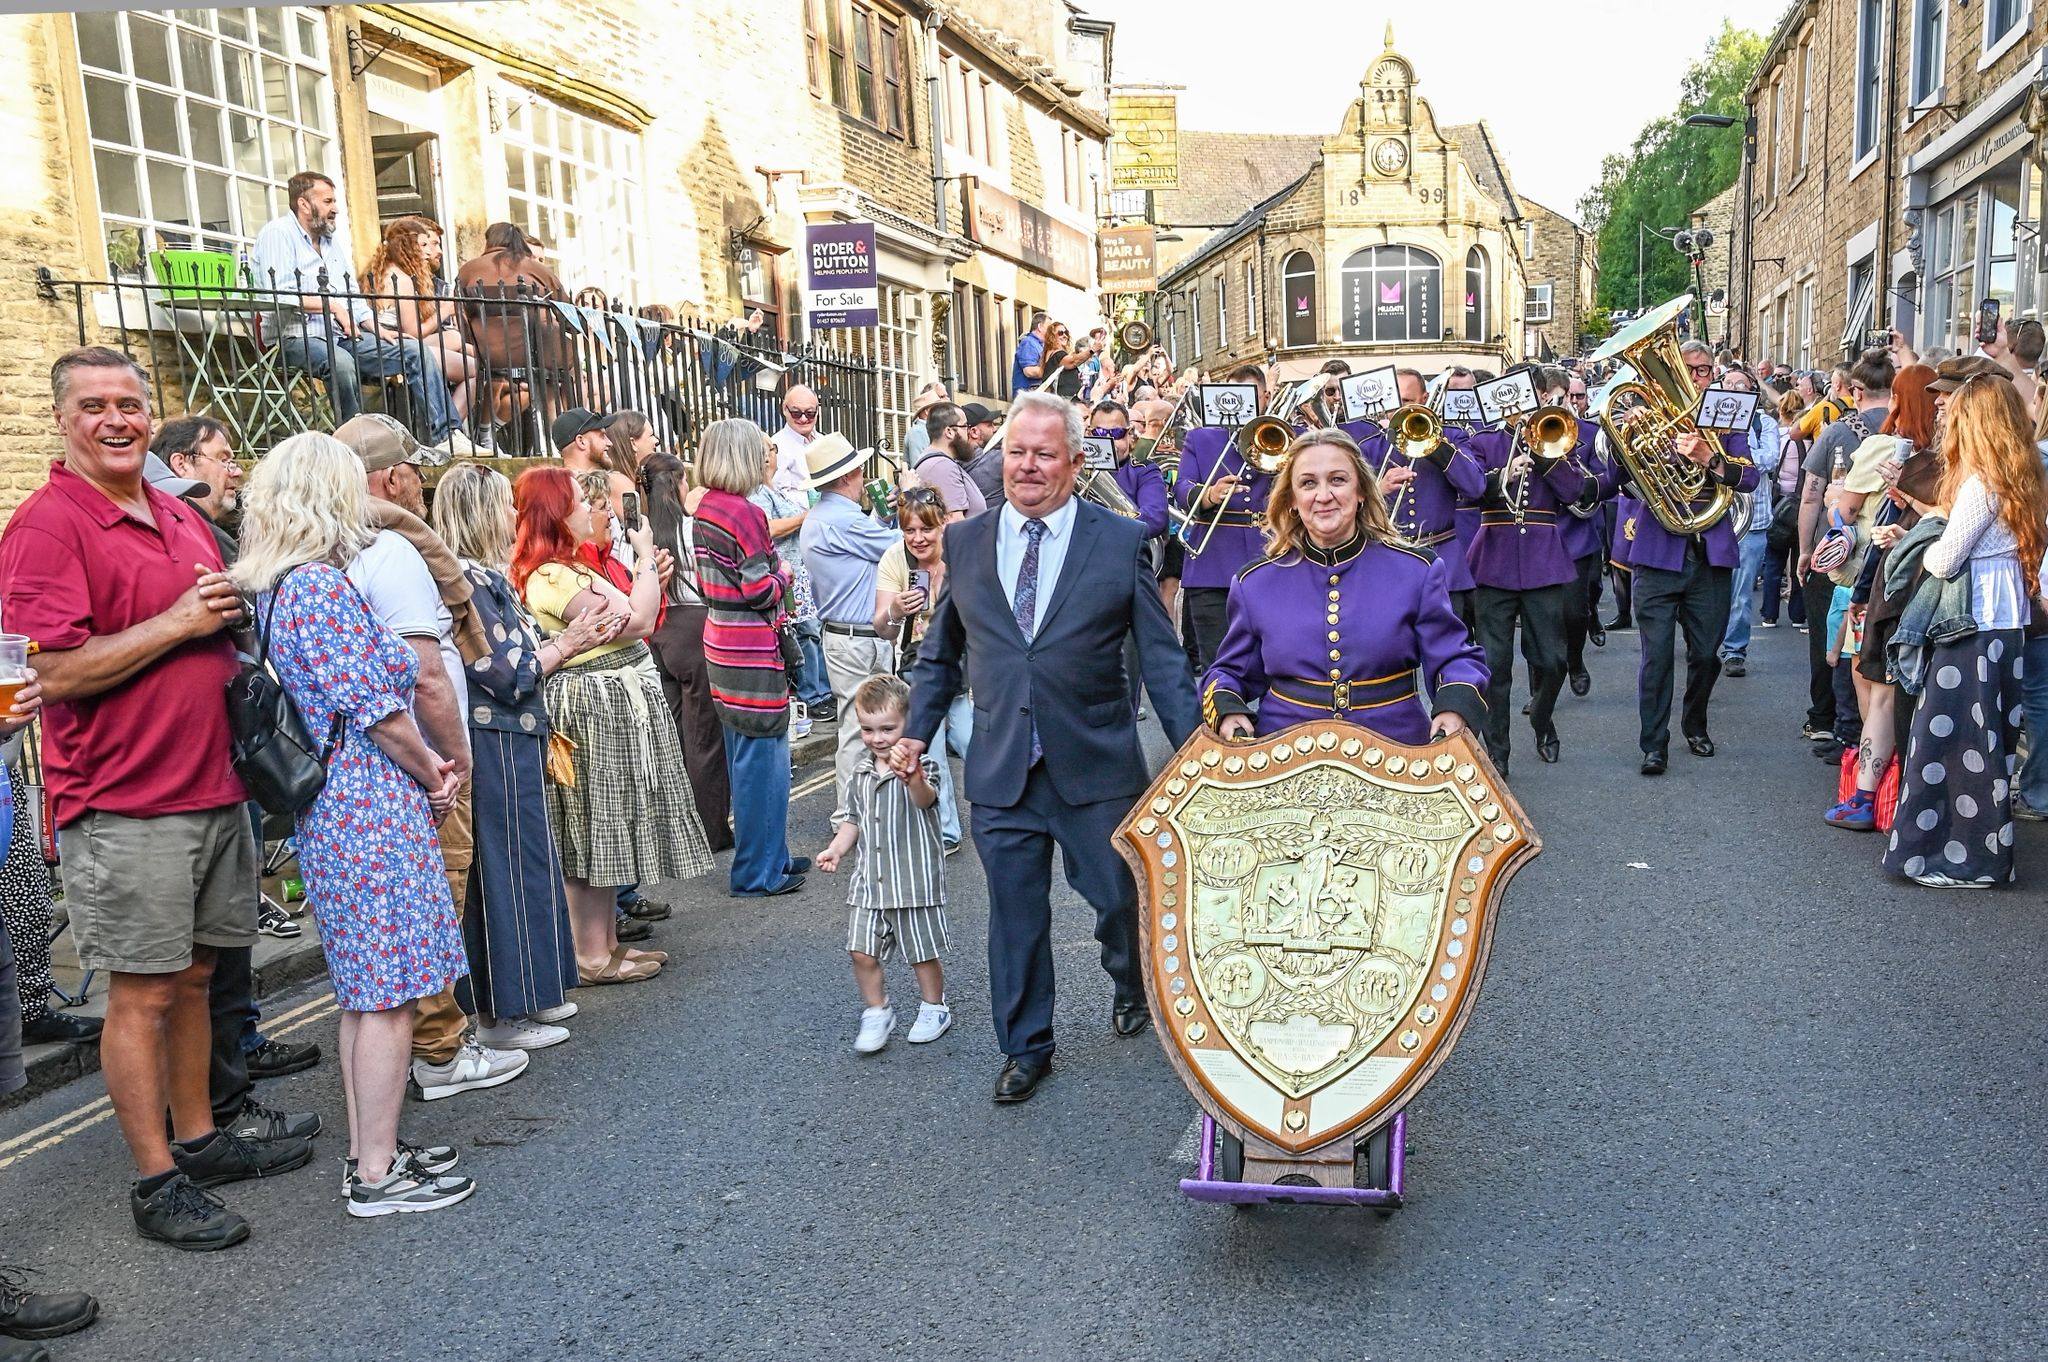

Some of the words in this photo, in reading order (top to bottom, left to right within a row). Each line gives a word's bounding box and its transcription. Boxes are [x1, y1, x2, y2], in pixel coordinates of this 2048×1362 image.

[1418, 187, 1443, 204] 99
[813, 242, 854, 256] RYDER
[1103, 245, 1132, 258] HAIR
[1134, 244, 1144, 256] &
[813, 255, 869, 269] DUTTON
[1103, 258, 1152, 272] BEAUTY
[815, 294, 836, 306] For
[839, 292, 864, 305] Sale
[720, 344, 734, 367] 80
[1221, 397, 1237, 405] B&R
[1721, 401, 1735, 409] B&R
[1384, 819, 1462, 838] ASSOCIATION
